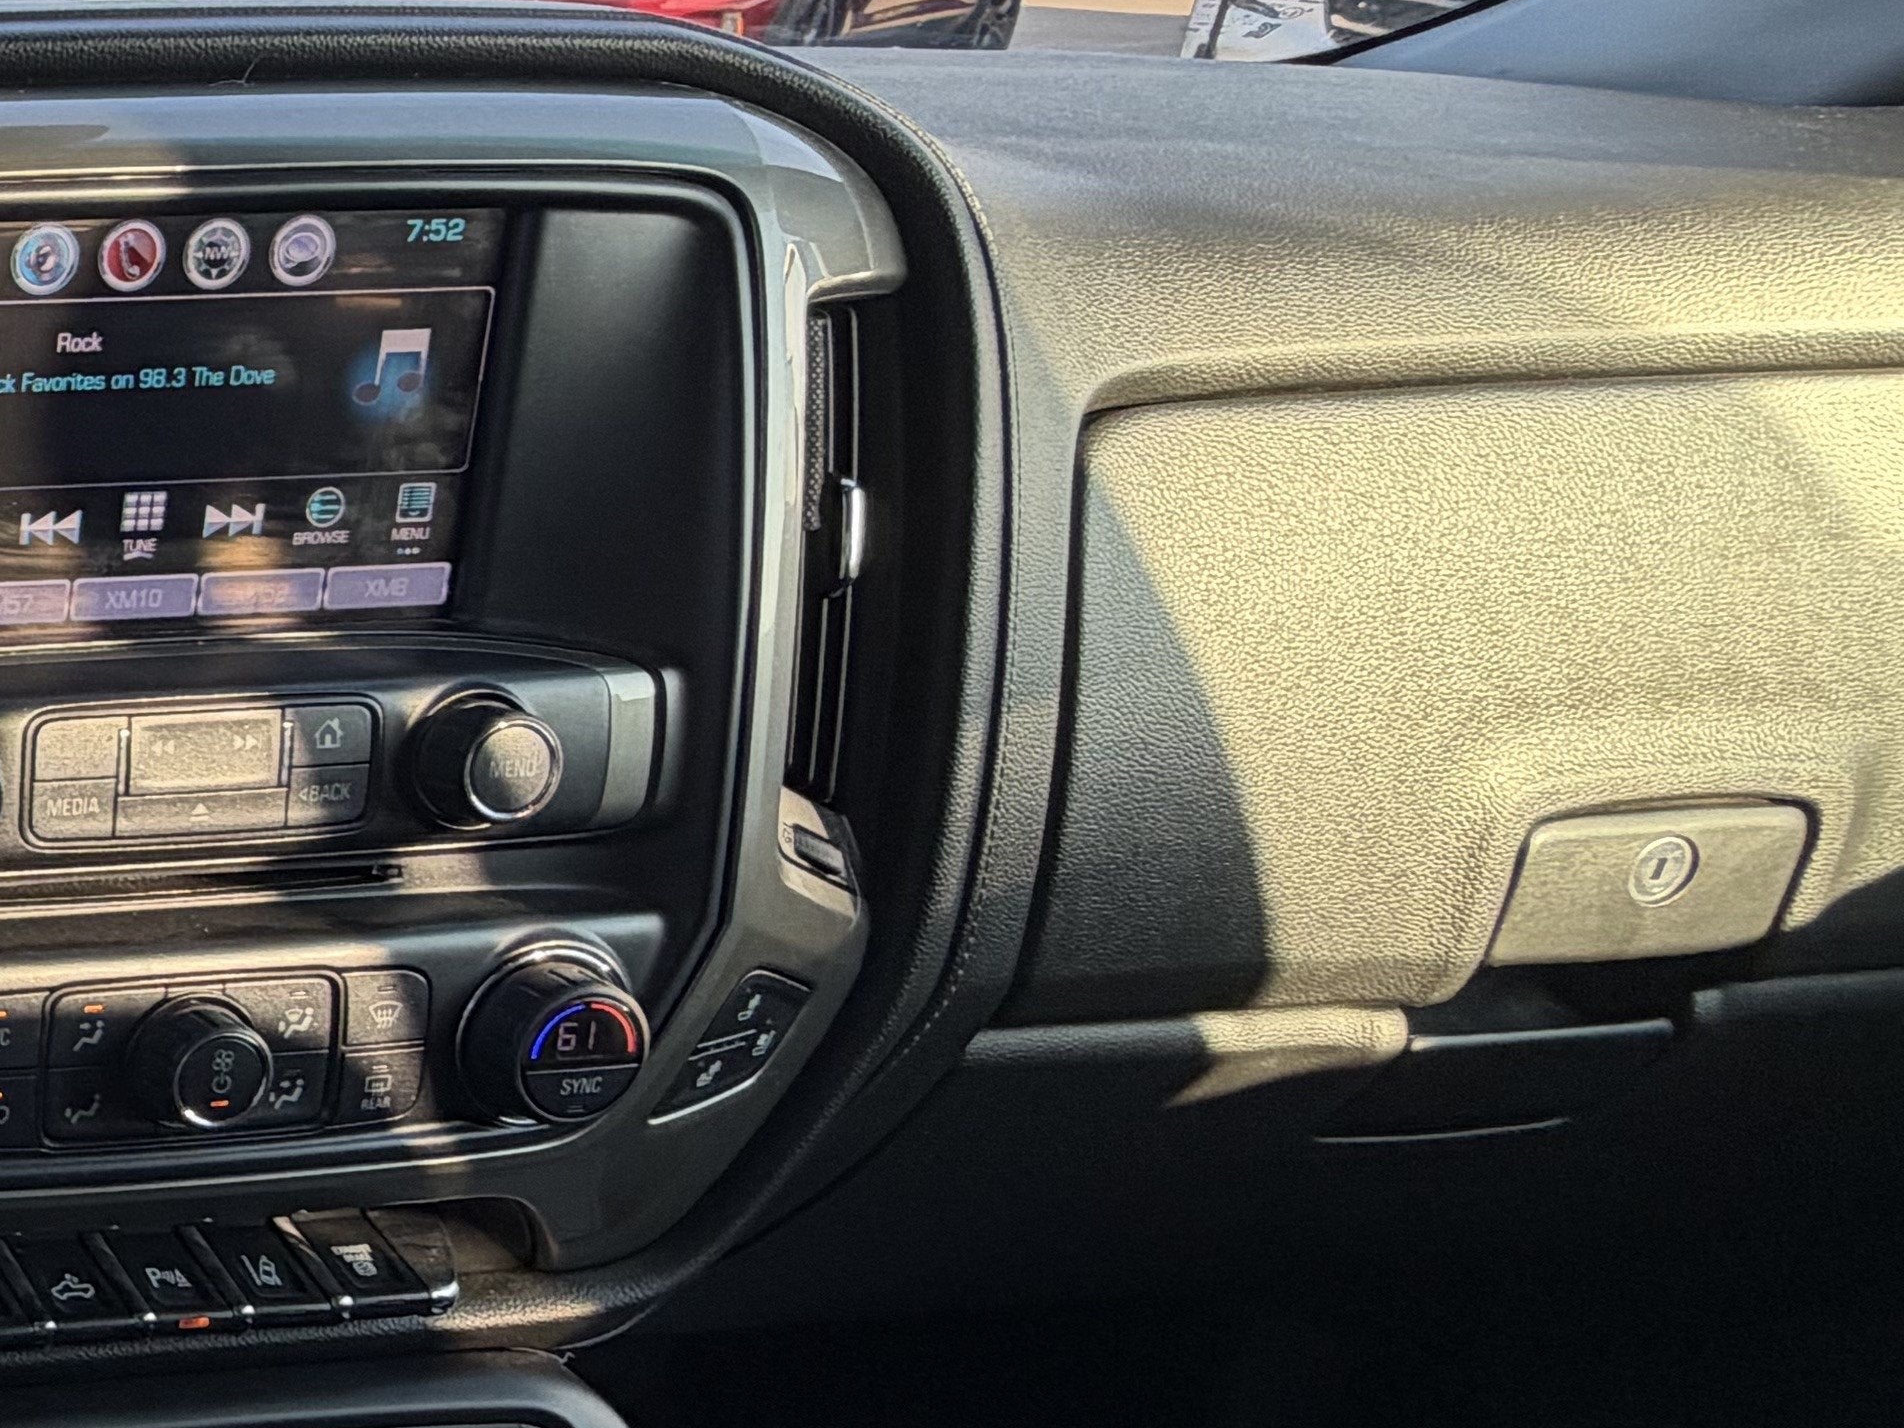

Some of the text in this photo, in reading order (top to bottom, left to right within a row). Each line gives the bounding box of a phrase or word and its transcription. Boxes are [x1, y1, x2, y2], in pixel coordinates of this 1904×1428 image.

[406, 218, 467, 243] 7:52
[56, 331, 103, 354] Rock
[20, 372, 106, 394] Favorites
[110, 374, 134, 390] on
[138, 367, 187, 390] 98.3
[191, 365, 224, 387] The
[229, 364, 276, 387] Dove
[292, 529, 351, 547] BROWSE
[391, 526, 431, 541] MENU
[122, 538, 158, 553] TUNE
[104, 588, 164, 610] XM10
[489, 756, 537, 779] MENU
[310, 782, 353, 802] BACK
[44, 796, 101, 818] MEDIA
[556, 1020, 598, 1052] 61
[560, 1076, 604, 1096] SYNC
